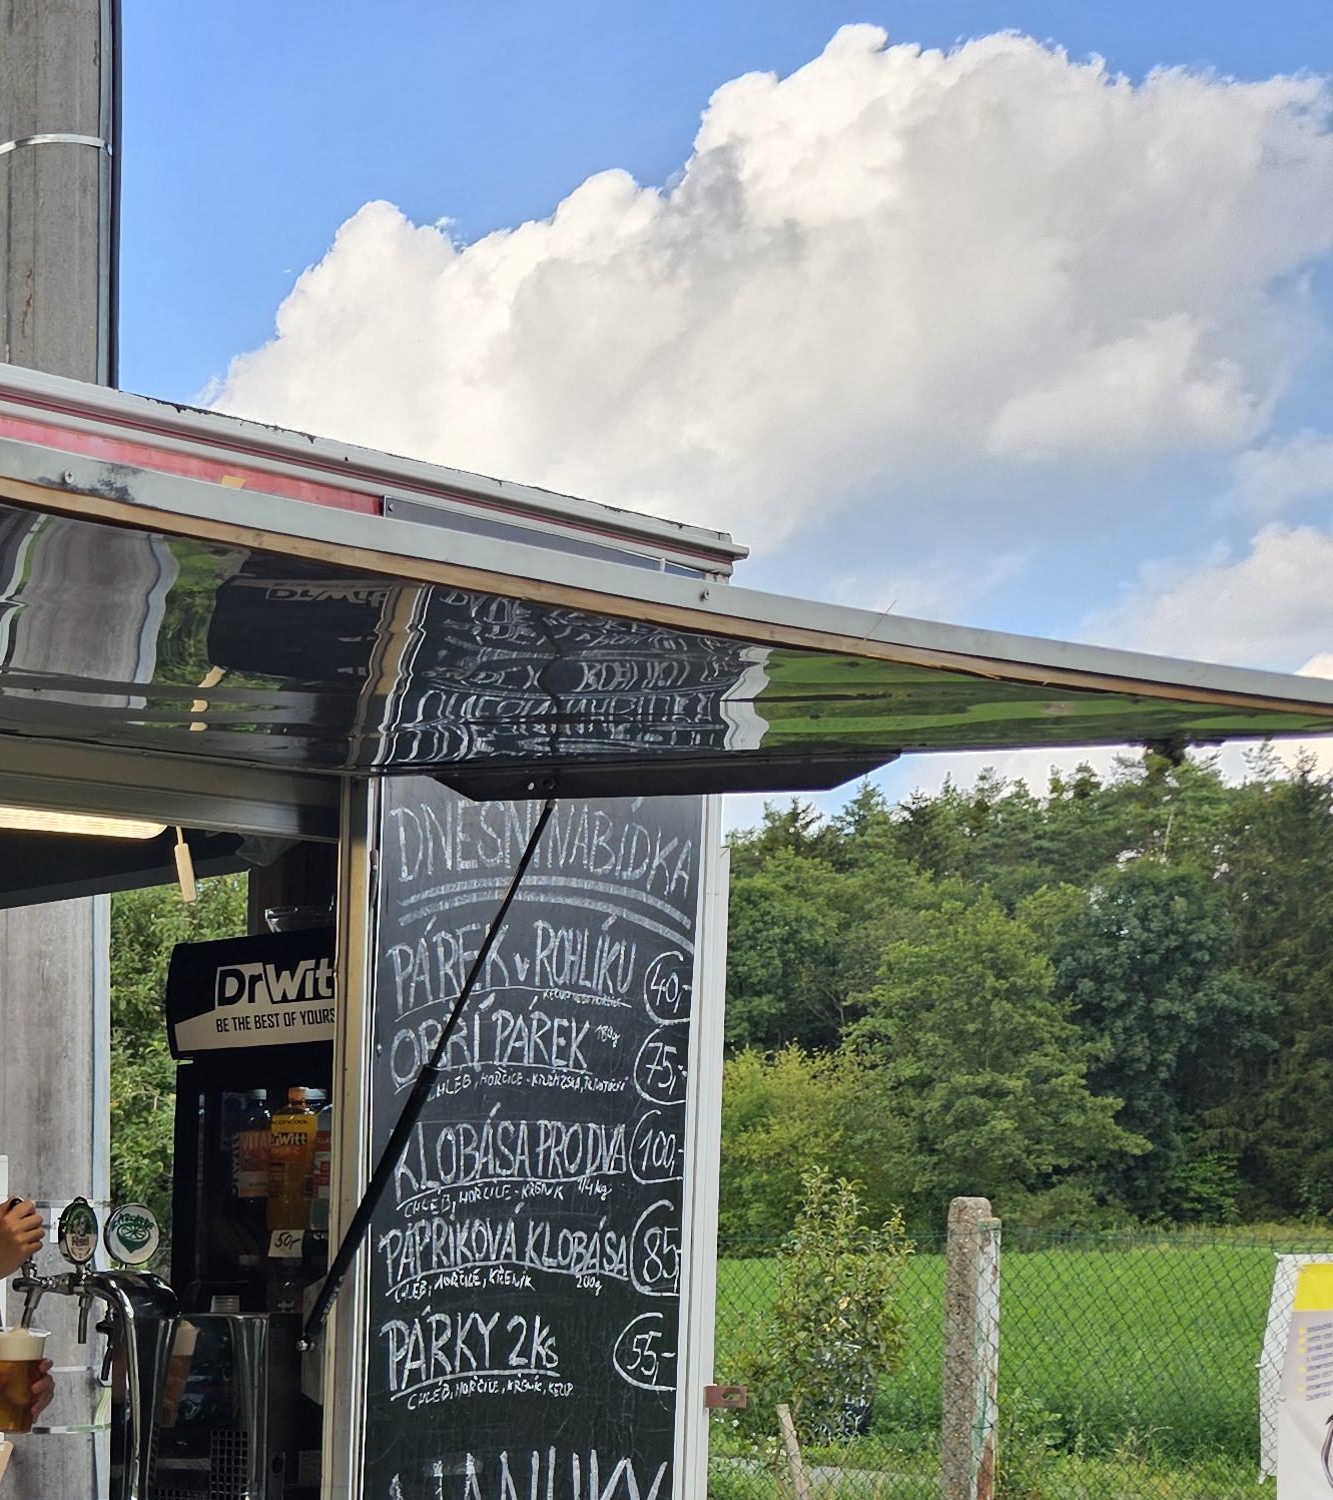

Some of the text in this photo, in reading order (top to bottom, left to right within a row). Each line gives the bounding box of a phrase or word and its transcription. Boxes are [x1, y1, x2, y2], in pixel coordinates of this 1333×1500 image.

[216, 957, 334, 1008] DrWit
[386, 916, 509, 1017] PÁREK
[534, 913, 636, 995] ROHLÍKU
[216, 1007, 334, 1033] BE THE BEST OF YOURS
[492, 994, 590, 1069] PÁREK
[395, 1101, 532, 1203] KLOBÁSA
[536, 1119, 584, 1178] PRO
[586, 1122, 627, 1176] DVA
[378, 1201, 517, 1288] PAPRIKOVÁ
[525, 1215, 629, 1277] KLOBÁSA
[379, 1305, 501, 1392] PÁRKY
